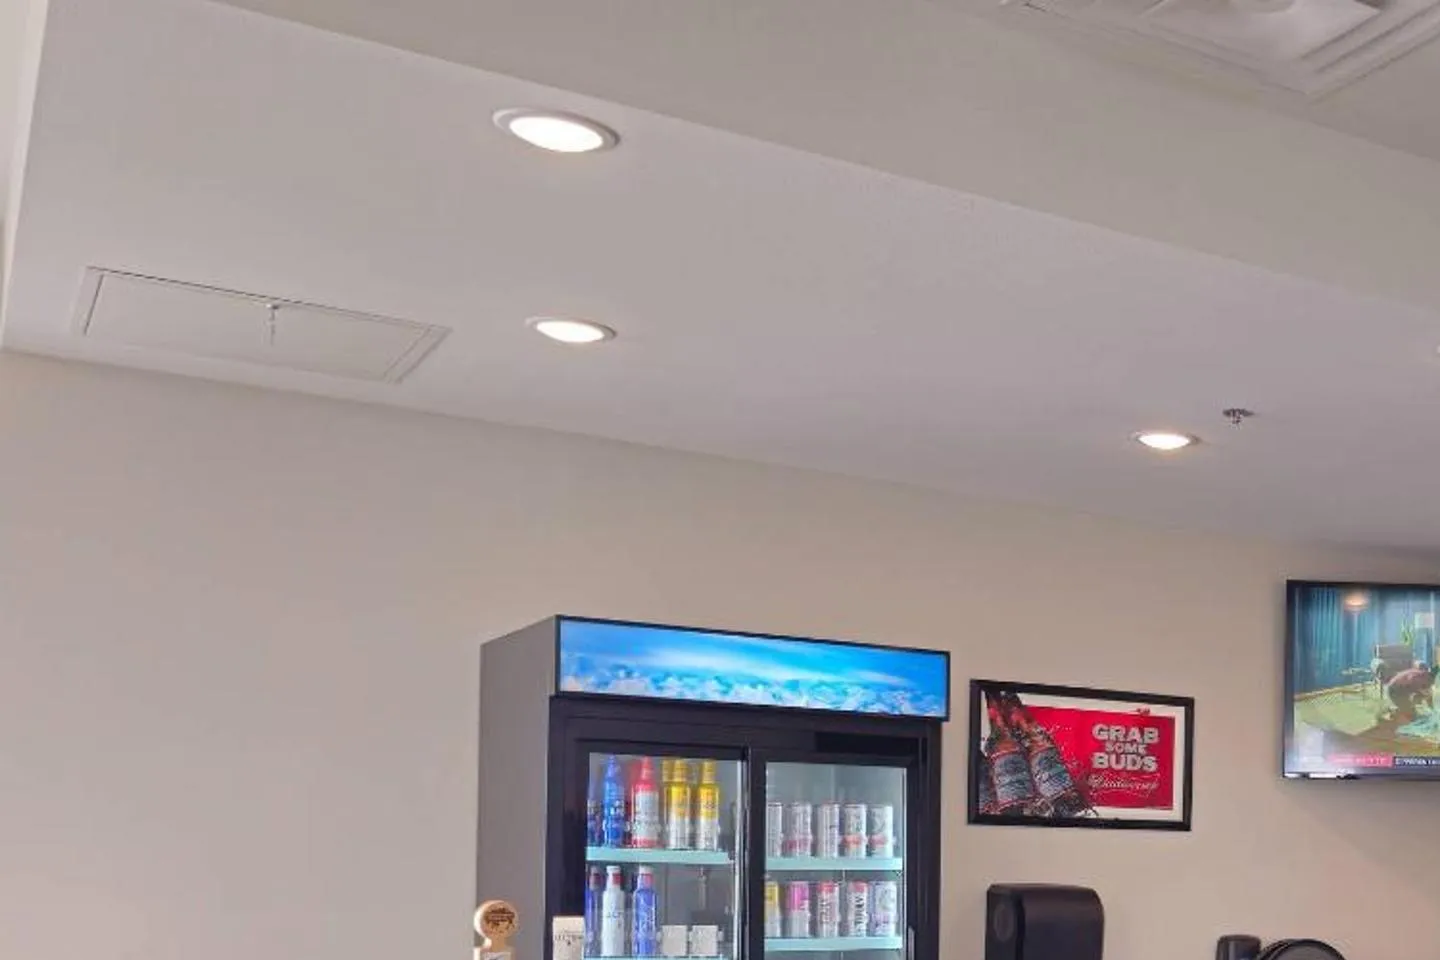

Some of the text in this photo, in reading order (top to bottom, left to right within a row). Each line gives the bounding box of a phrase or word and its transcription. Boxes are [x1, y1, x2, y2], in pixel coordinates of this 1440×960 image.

[1091, 723, 1159, 744] GRAB
[1105, 741, 1148, 755] SOME
[1091, 752, 1158, 772] BUDS
